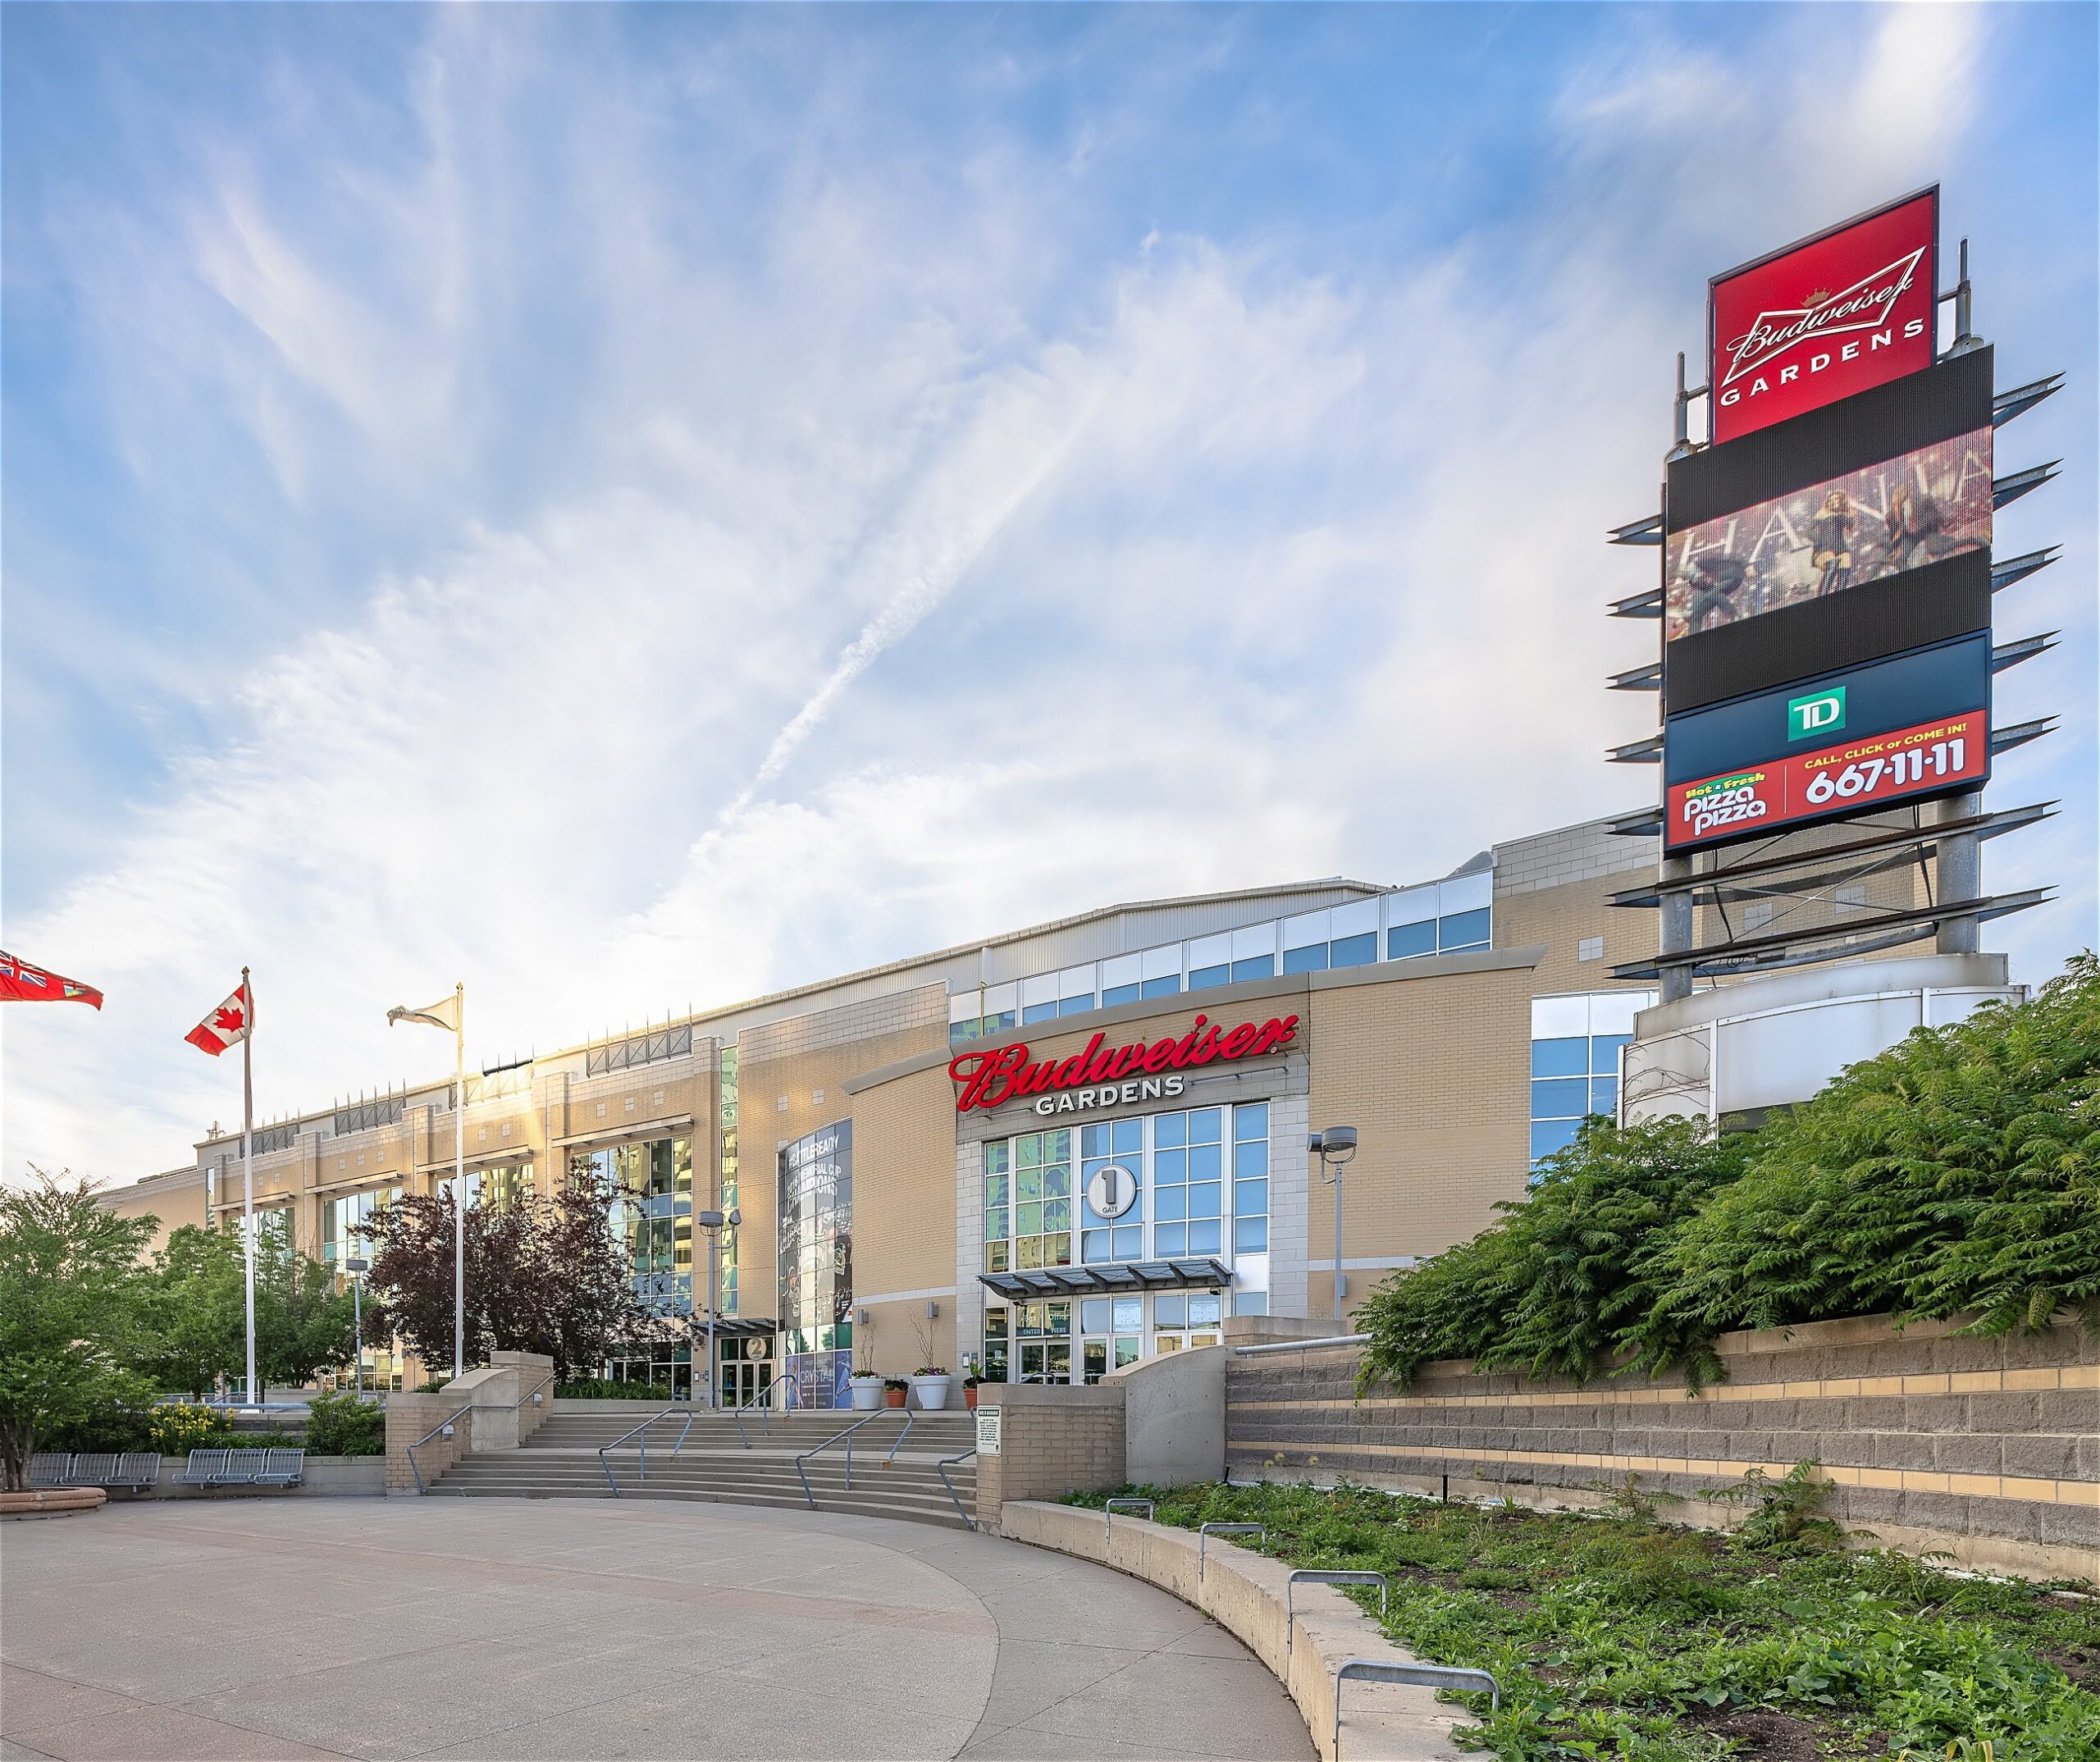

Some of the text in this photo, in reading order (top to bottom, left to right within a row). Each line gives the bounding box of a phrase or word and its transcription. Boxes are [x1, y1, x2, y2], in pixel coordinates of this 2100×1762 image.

[1726, 277, 1914, 363] Budweiser
[1720, 318, 1924, 407] GARDENS
[1793, 697, 1840, 730] TD
[1805, 723, 1968, 769] CALL, CLICK or COME IN!
[1685, 785, 1713, 799] Hot
[1723, 772, 1766, 789] Fresh
[948, 1014, 1299, 1113] Budweiser
[1034, 1075, 1186, 1116] GARDENS
[1102, 1169, 1116, 1204] 1
[1102, 1205, 1118, 1214] GATE
[1049, 1312, 1069, 1321] Office
[751, 1338, 762, 1355] 2
[800, 1367, 833, 1384] CRYSTAL
